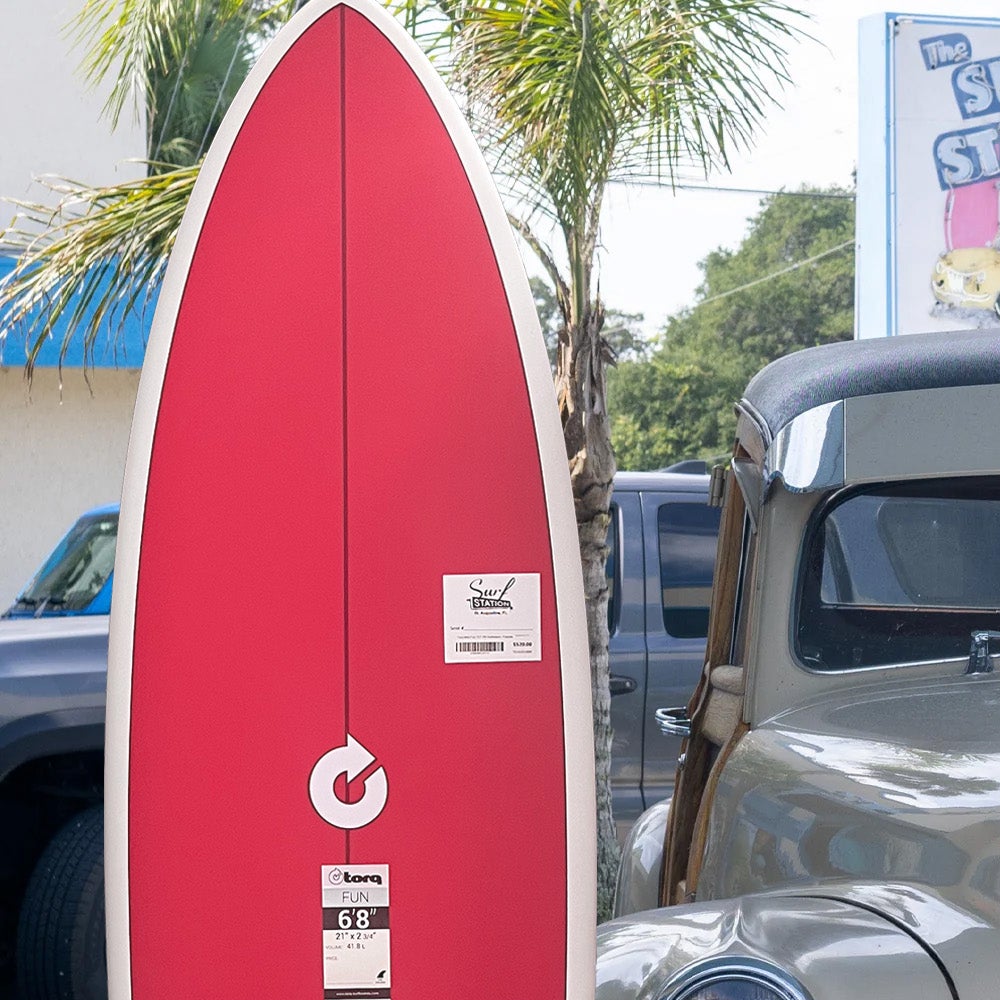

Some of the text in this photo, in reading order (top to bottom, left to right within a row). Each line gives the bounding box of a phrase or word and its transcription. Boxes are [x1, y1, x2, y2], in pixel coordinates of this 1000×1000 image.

[922, 40, 971, 68] The
[473, 598, 511, 608] STATION
[343, 871, 383, 885] torq
[342, 891, 369, 904] FUN
[338, 908, 377, 930] 6'8"
[356, 931, 362, 940] 2
